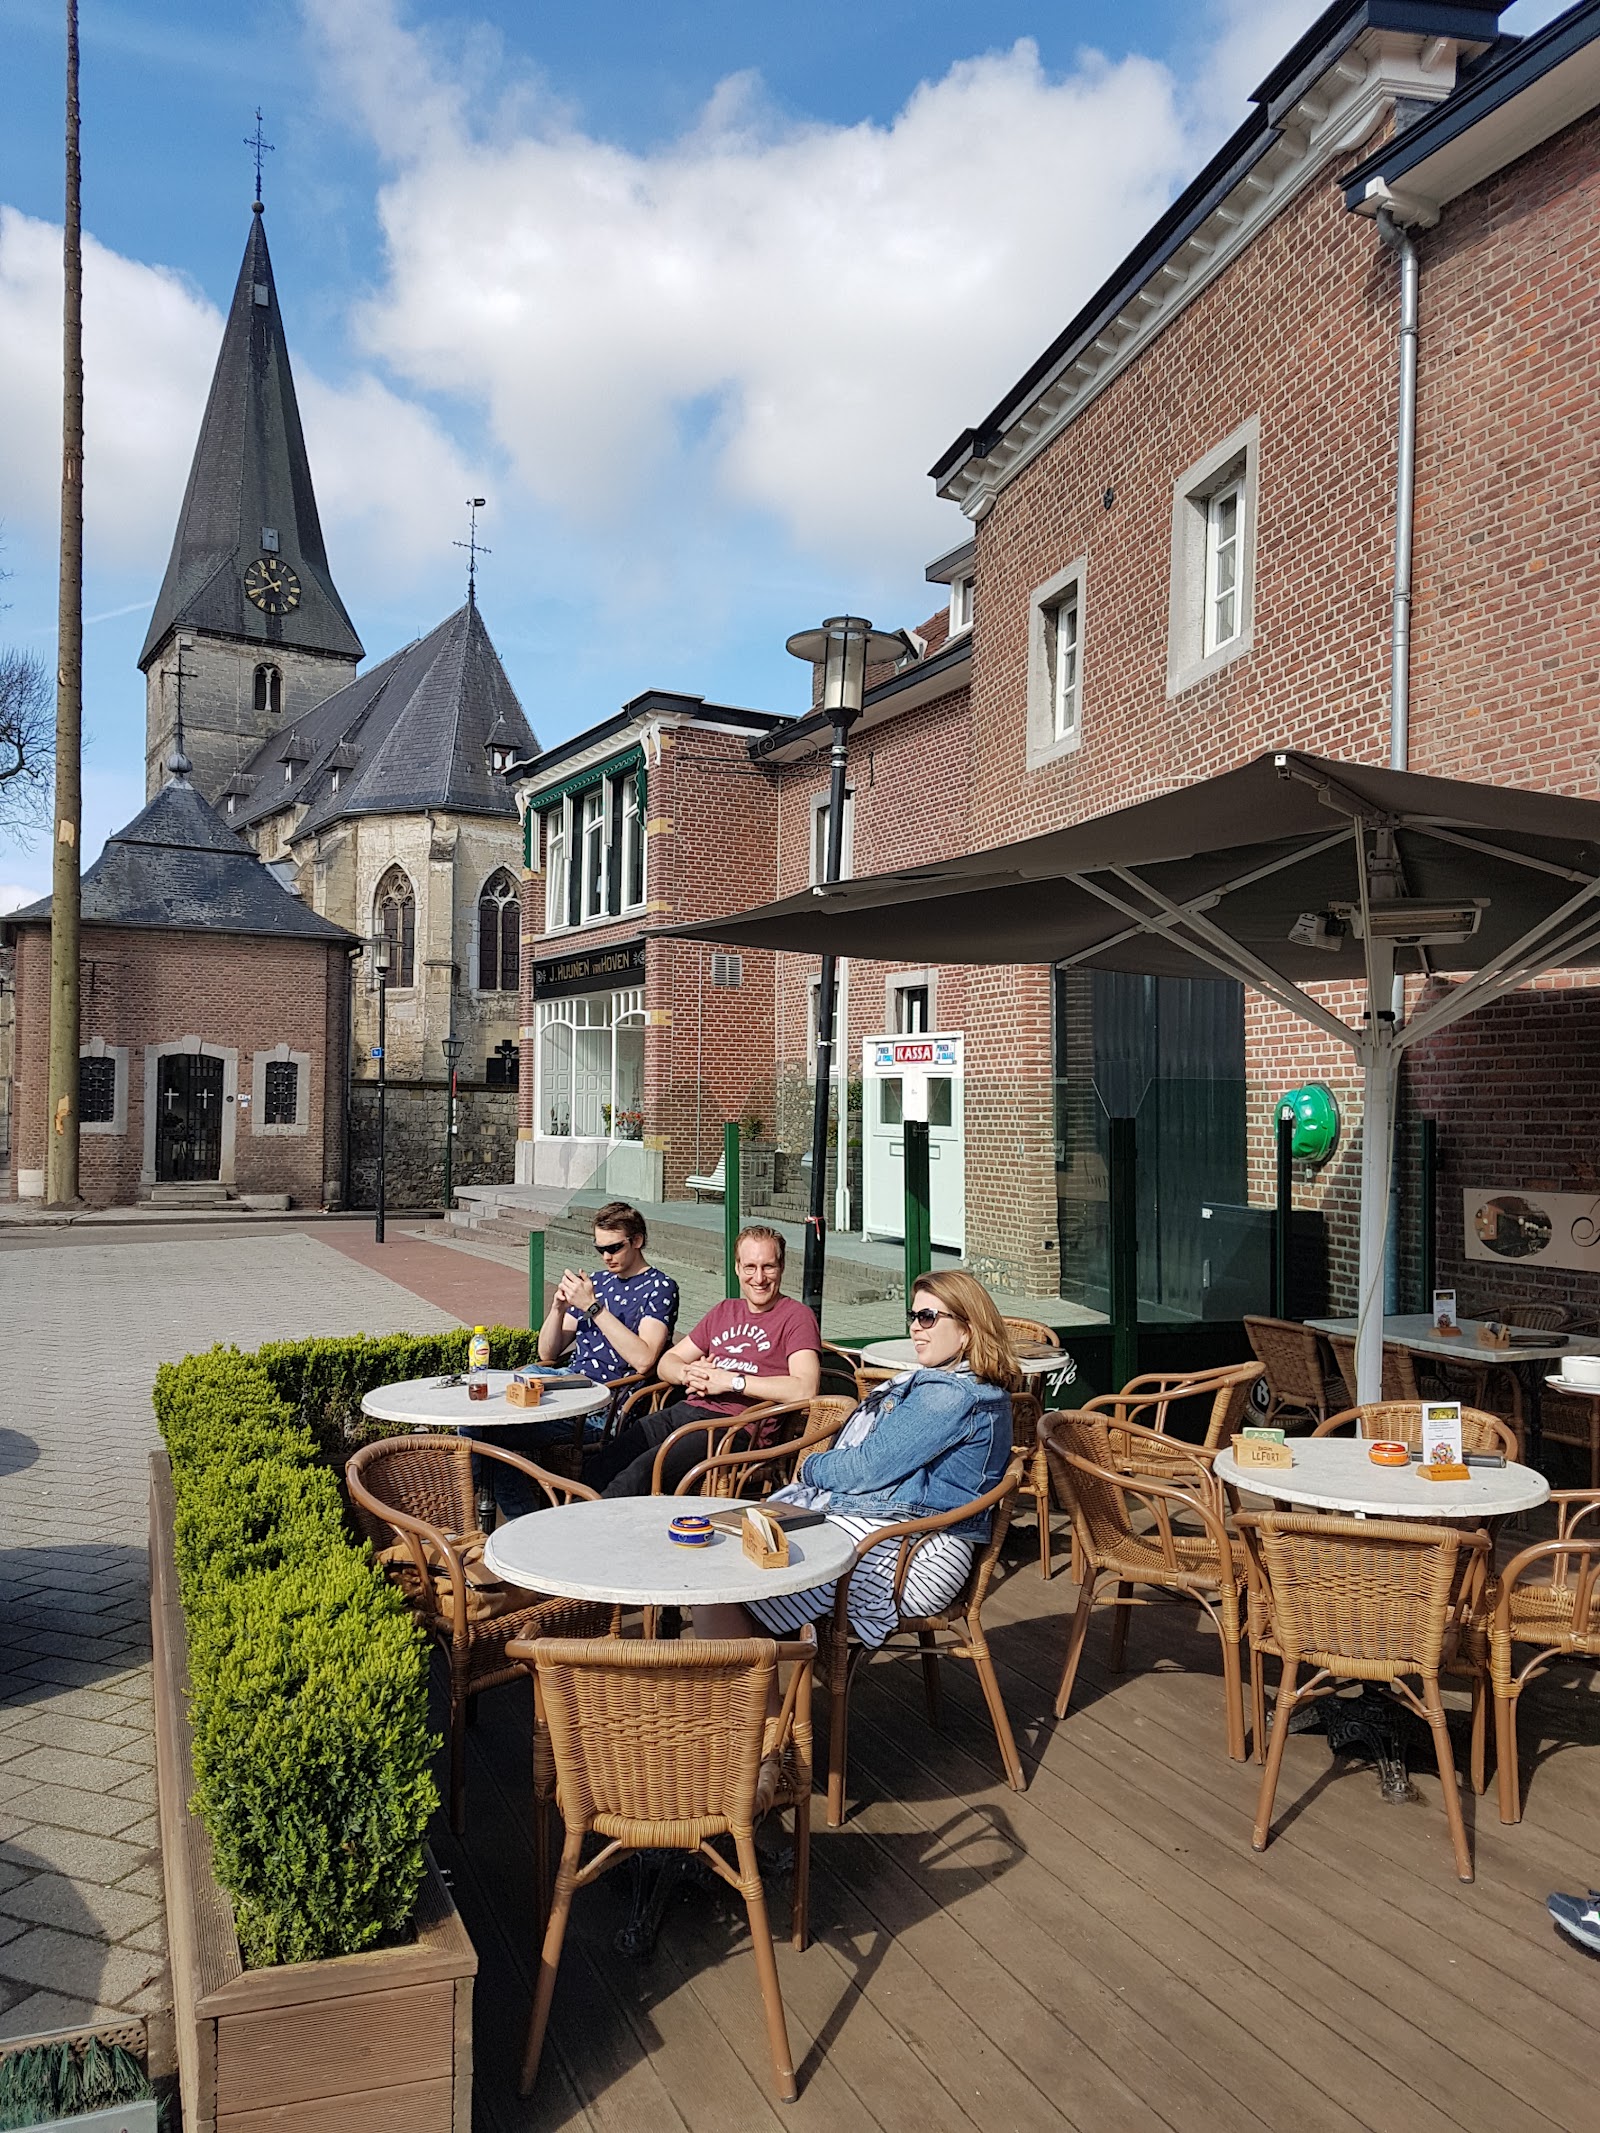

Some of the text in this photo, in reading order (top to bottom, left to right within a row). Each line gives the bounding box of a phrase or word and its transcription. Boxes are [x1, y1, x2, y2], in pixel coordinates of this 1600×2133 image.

[600, 950, 630, 973] HOVEN
[896, 1045, 932, 1061] KASSA
[1046, 1358, 1078, 1397] afé
